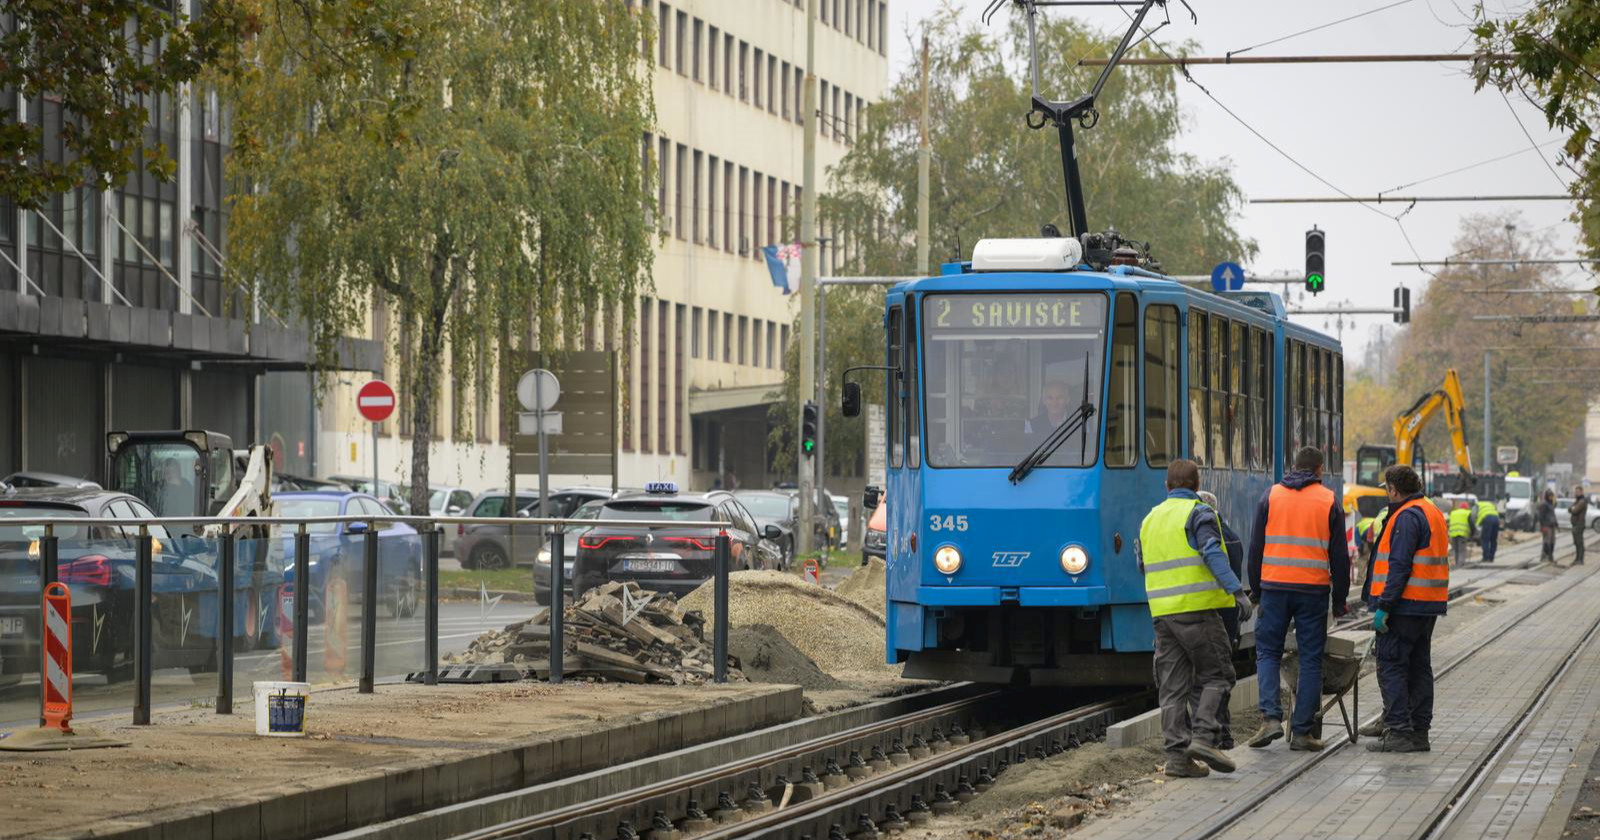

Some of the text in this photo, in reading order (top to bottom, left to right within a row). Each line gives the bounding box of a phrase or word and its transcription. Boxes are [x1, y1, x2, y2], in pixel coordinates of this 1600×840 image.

[937, 298, 951, 327] 2
[650, 482, 673, 491] TAXI
[930, 514, 969, 532] 345
[992, 551, 1031, 567] ZET
